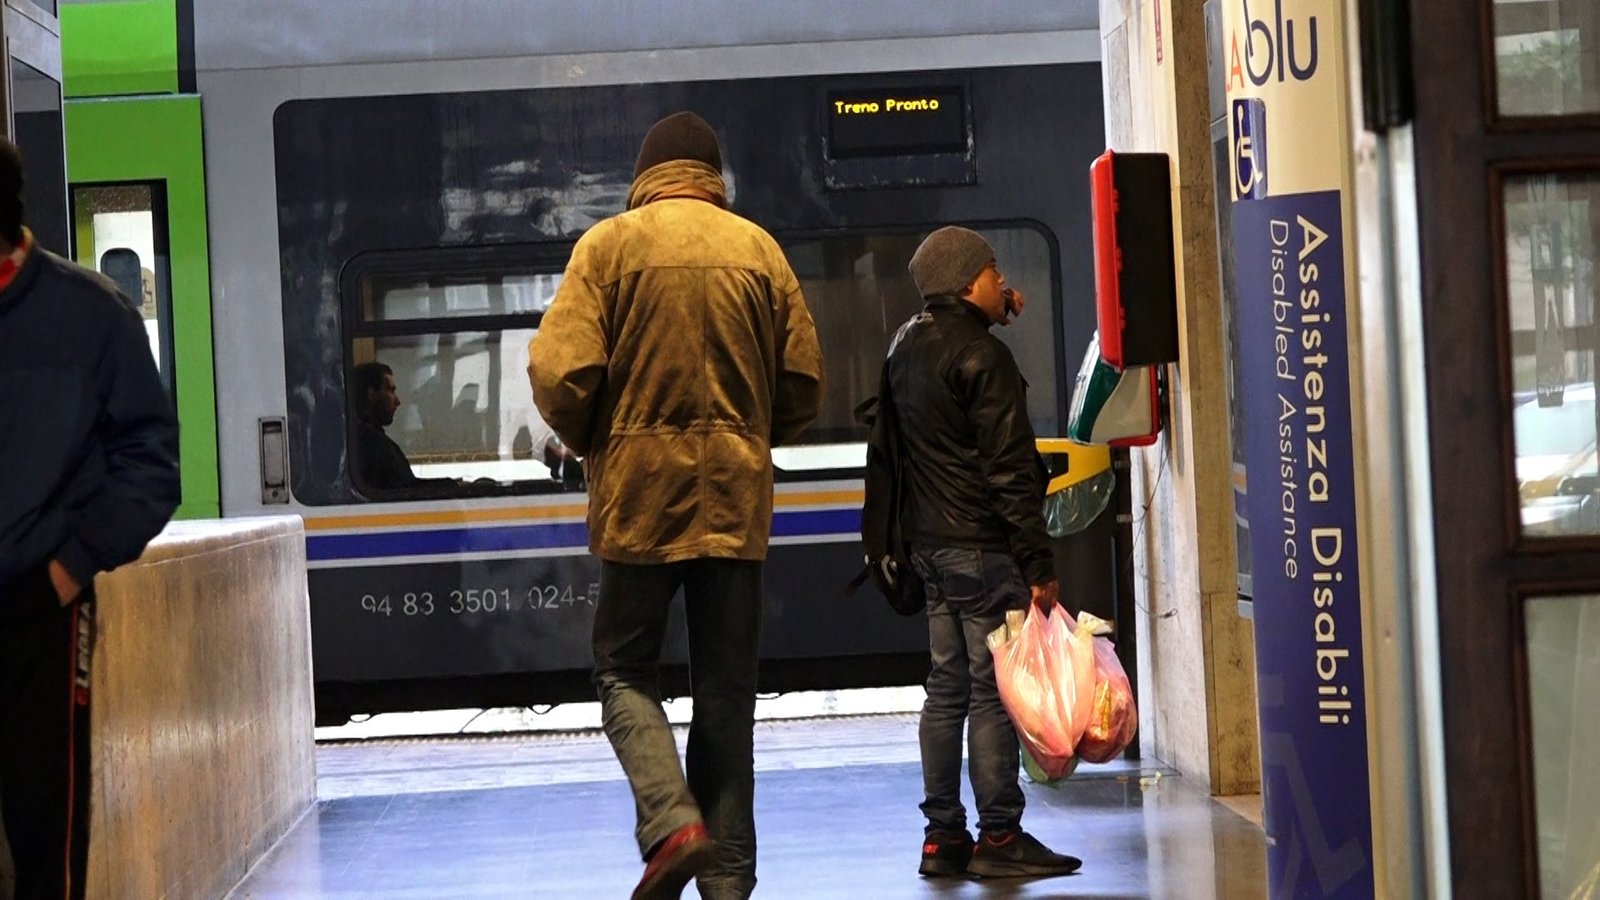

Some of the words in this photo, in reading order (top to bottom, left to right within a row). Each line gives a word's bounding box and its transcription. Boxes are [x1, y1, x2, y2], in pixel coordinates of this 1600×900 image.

[834, 101, 879, 114] Treno
[886, 99, 939, 112] Pronto
[1243, 0, 1318, 86] blu
[1270, 219, 1297, 380] Disabled
[1296, 214, 1330, 502] Assistenza
[1277, 393, 1298, 580] Assistance
[361, 594, 392, 616] 94
[403, 592, 435, 616] 83
[449, 588, 511, 613] 3501
[1311, 527, 1352, 725] Disabili
